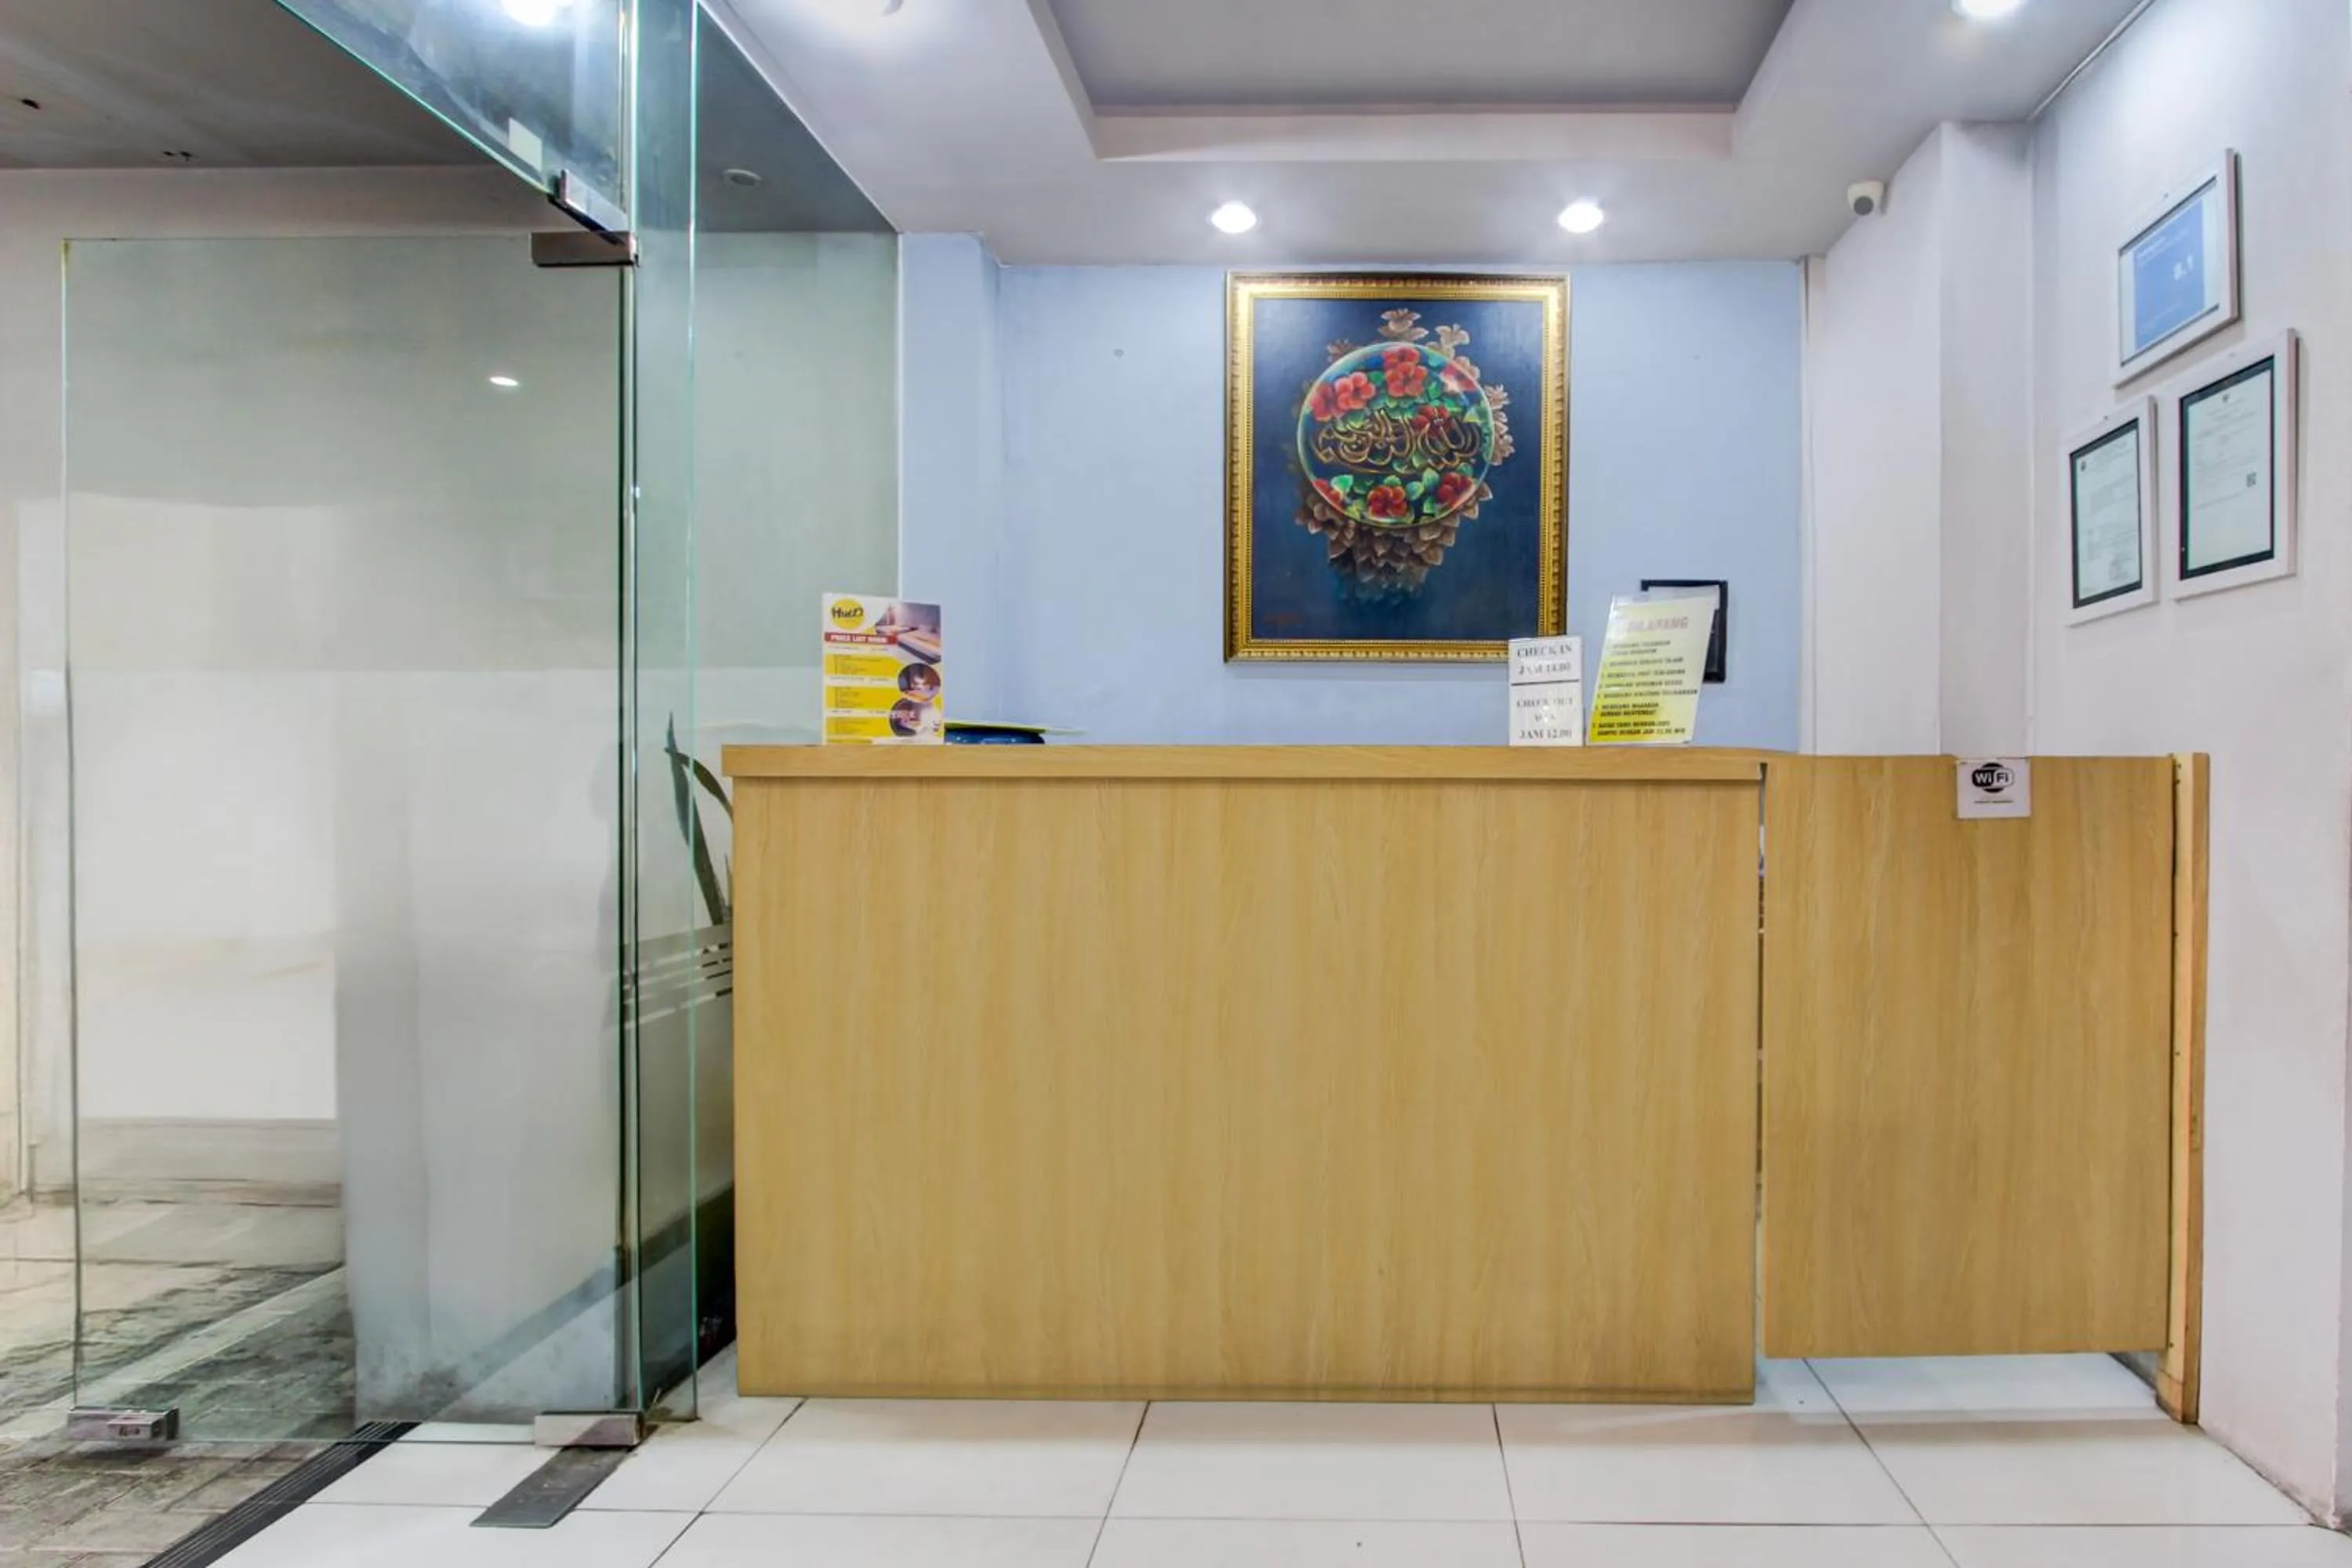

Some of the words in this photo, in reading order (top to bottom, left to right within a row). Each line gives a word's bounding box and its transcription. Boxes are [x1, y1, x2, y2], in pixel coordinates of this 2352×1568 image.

[1517, 646, 1557, 657] CHECK
[1559, 644, 1572, 654] IN
[1519, 730, 1544, 739] JAM
